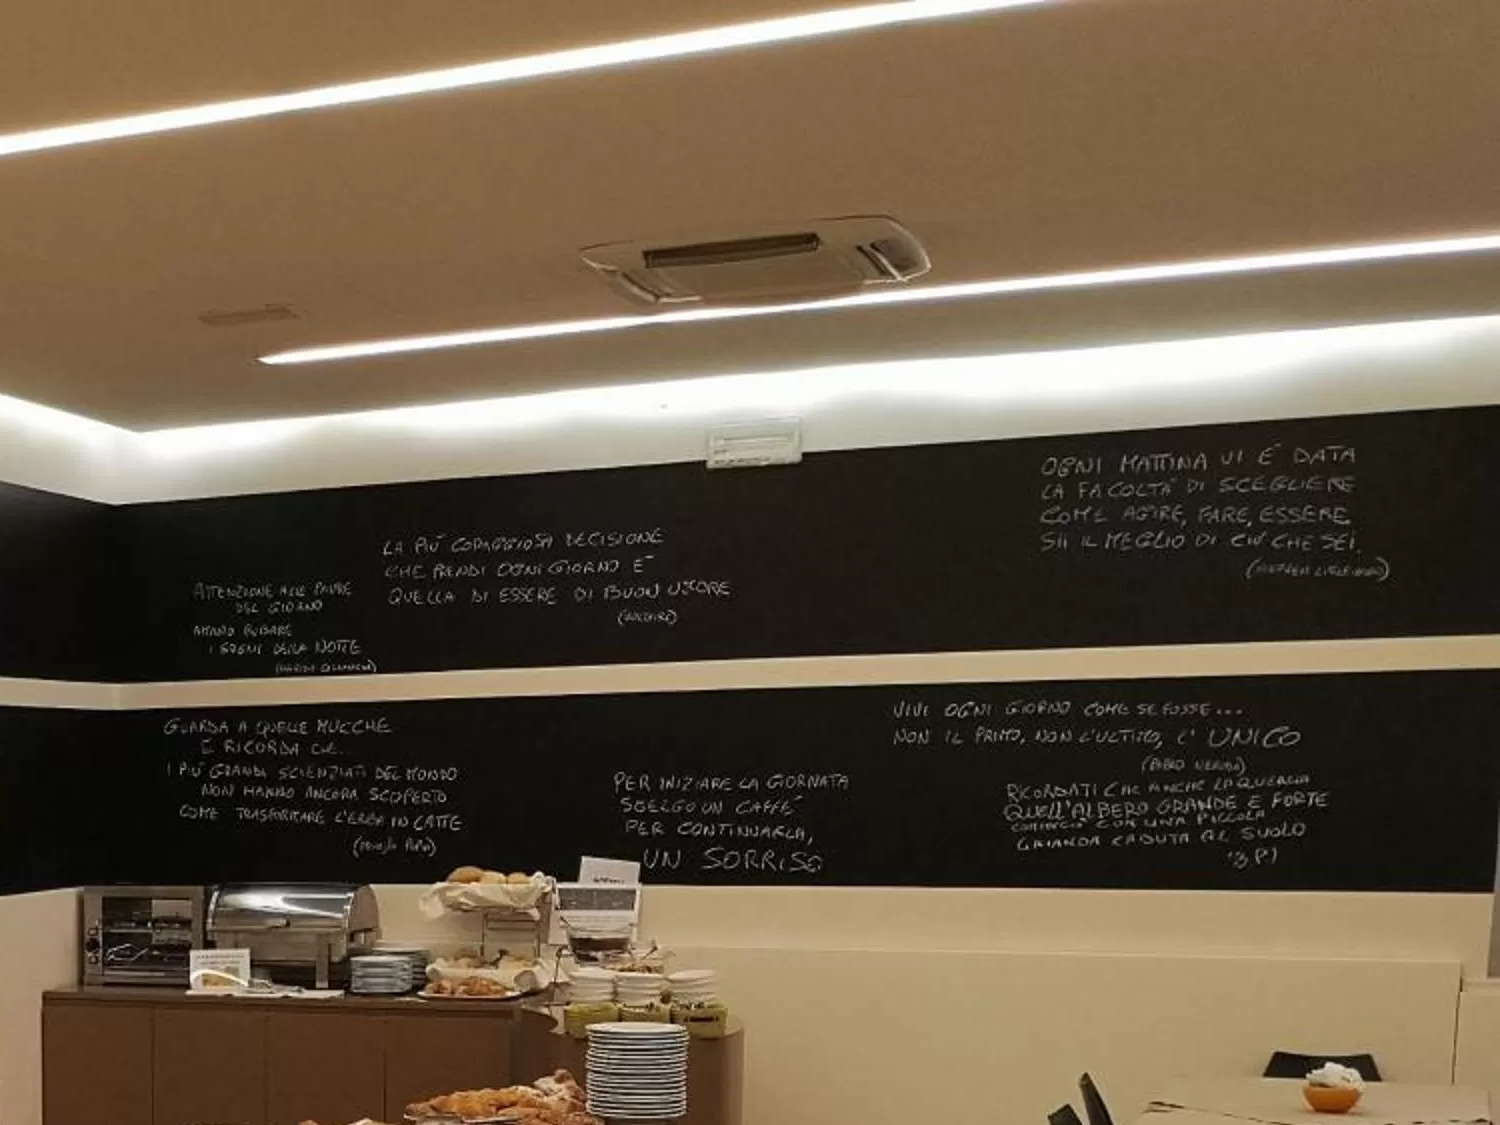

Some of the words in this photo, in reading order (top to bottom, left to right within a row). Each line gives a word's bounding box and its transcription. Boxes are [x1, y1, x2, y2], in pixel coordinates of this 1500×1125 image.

[1041, 457, 1101, 477] OGNI
[1119, 453, 1207, 474] MATTINA
[1221, 449, 1243, 465] VI
[1293, 445, 1356, 465] DATA
[1041, 483, 1065, 500] LA
[1187, 479, 1205, 495] DI
[1219, 475, 1356, 493] SCEGLIERE
[1040, 505, 1108, 525] COME
[382, 540, 403, 556] LA
[566, 528, 664, 548] DECISIONE
[1104, 530, 1186, 551] MEGLIO
[1270, 533, 1315, 551] CHE
[384, 563, 427, 580] CHE
[432, 563, 487, 580] PRENDI
[497, 562, 543, 577] OGNI
[548, 559, 620, 575] GIORNO
[388, 587, 456, 605] QUELLA
[471, 588, 489, 603] DI
[499, 587, 558, 605] ESSERE
[574, 586, 593, 602] DI
[603, 582, 659, 600] BUON
[314, 639, 361, 655] NOTTE
[893, 700, 930, 719] VIVI
[944, 702, 991, 719] OGNI
[1005, 700, 1071, 716] GIORNO
[1083, 702, 1130, 717] COME
[164, 717, 229, 735] GUARDA
[237, 720, 247, 733] A
[317, 717, 393, 735] MUCCHE
[893, 728, 930, 745] NON
[1035, 729, 1073, 744] NON
[201, 738, 215, 755] E
[223, 739, 299, 757] RICORDA
[375, 765, 402, 781] DEL
[406, 766, 459, 781] MONDO
[613, 771, 650, 794] PER
[739, 777, 759, 791] LA
[201, 783, 235, 798] NON
[243, 785, 295, 799] HANNO
[305, 785, 358, 801] ANCORA
[368, 787, 447, 805] SCOPERTO
[1156, 795, 1237, 815] GRANDE
[1271, 791, 1332, 809] FORTE
[179, 803, 219, 820] COME
[701, 800, 723, 815] UN
[625, 820, 665, 836] PER
[1143, 816, 1187, 828] UNA
[1241, 821, 1307, 841] SUOLO
[643, 848, 681, 870] UN
[700, 846, 823, 873] SORRISO
